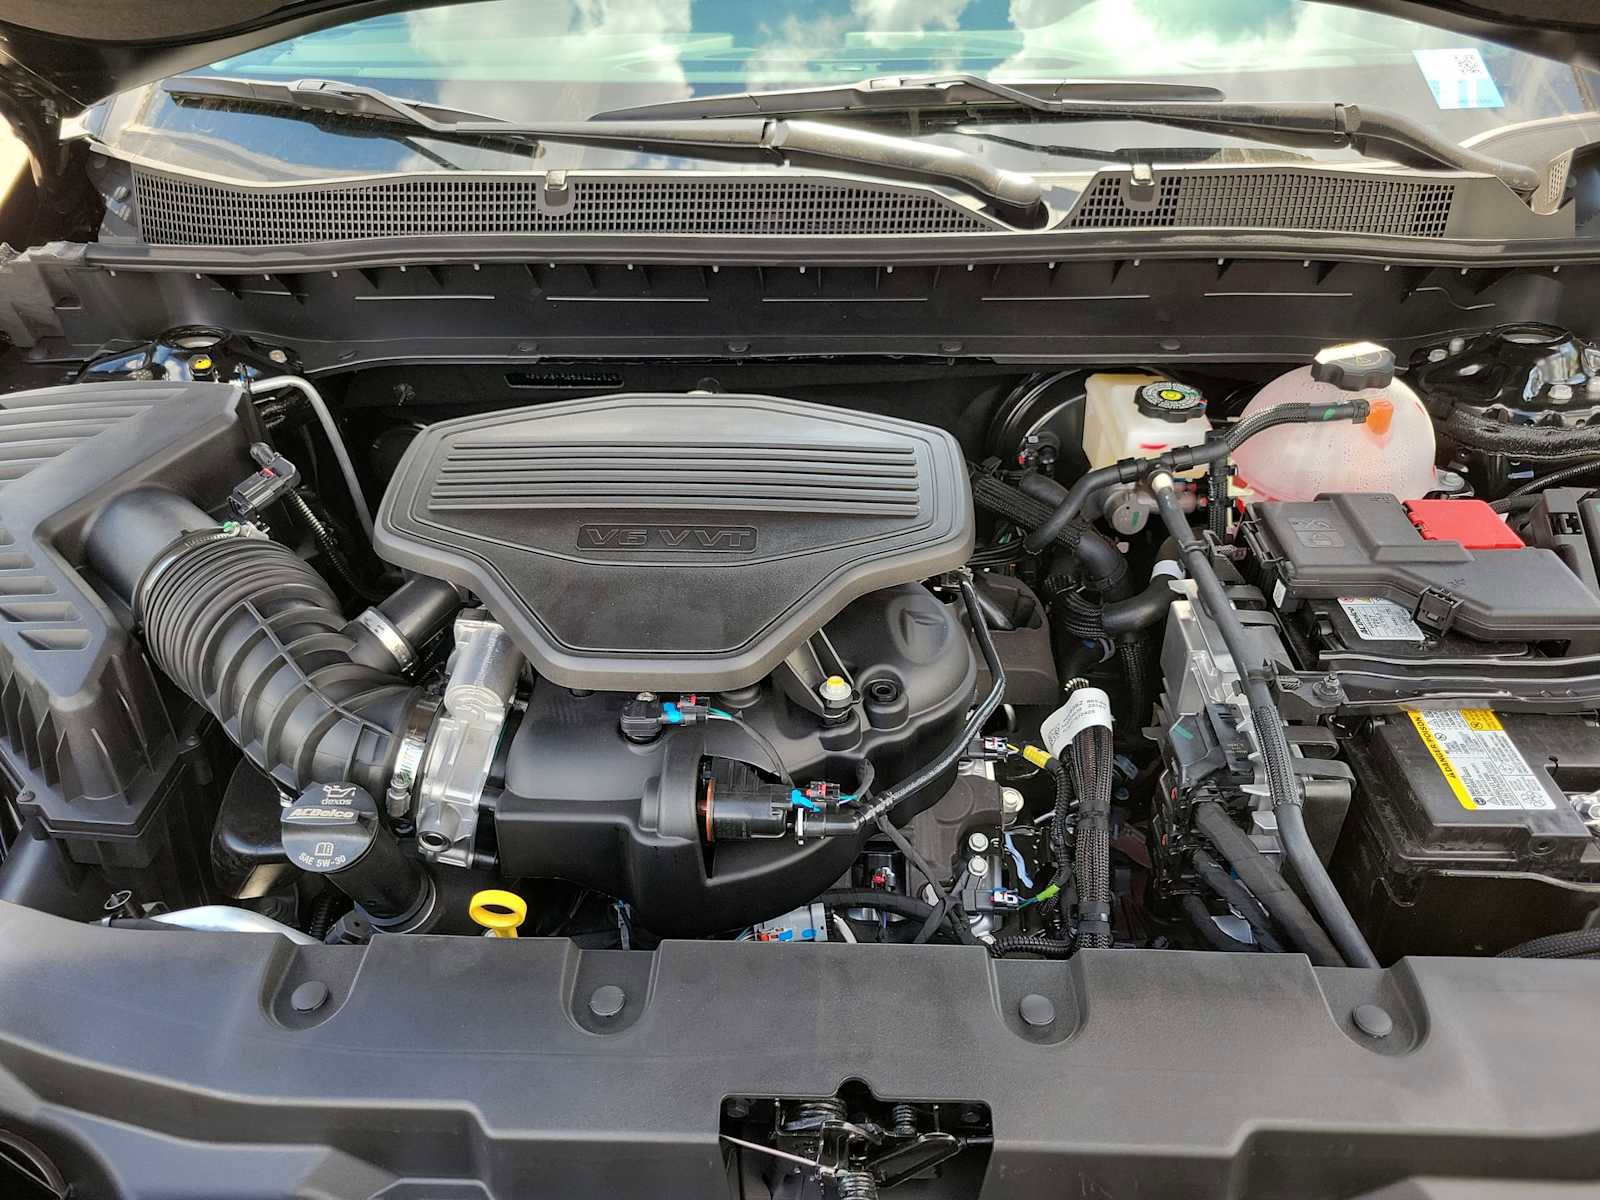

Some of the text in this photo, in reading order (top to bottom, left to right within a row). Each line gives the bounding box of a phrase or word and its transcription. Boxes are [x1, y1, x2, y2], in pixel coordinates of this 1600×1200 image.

[586, 528, 751, 547] V6 VVT
[321, 798, 352, 806] dexos
[290, 808, 354, 818] ACDelco
[298, 852, 346, 867] SAE 5W-30
